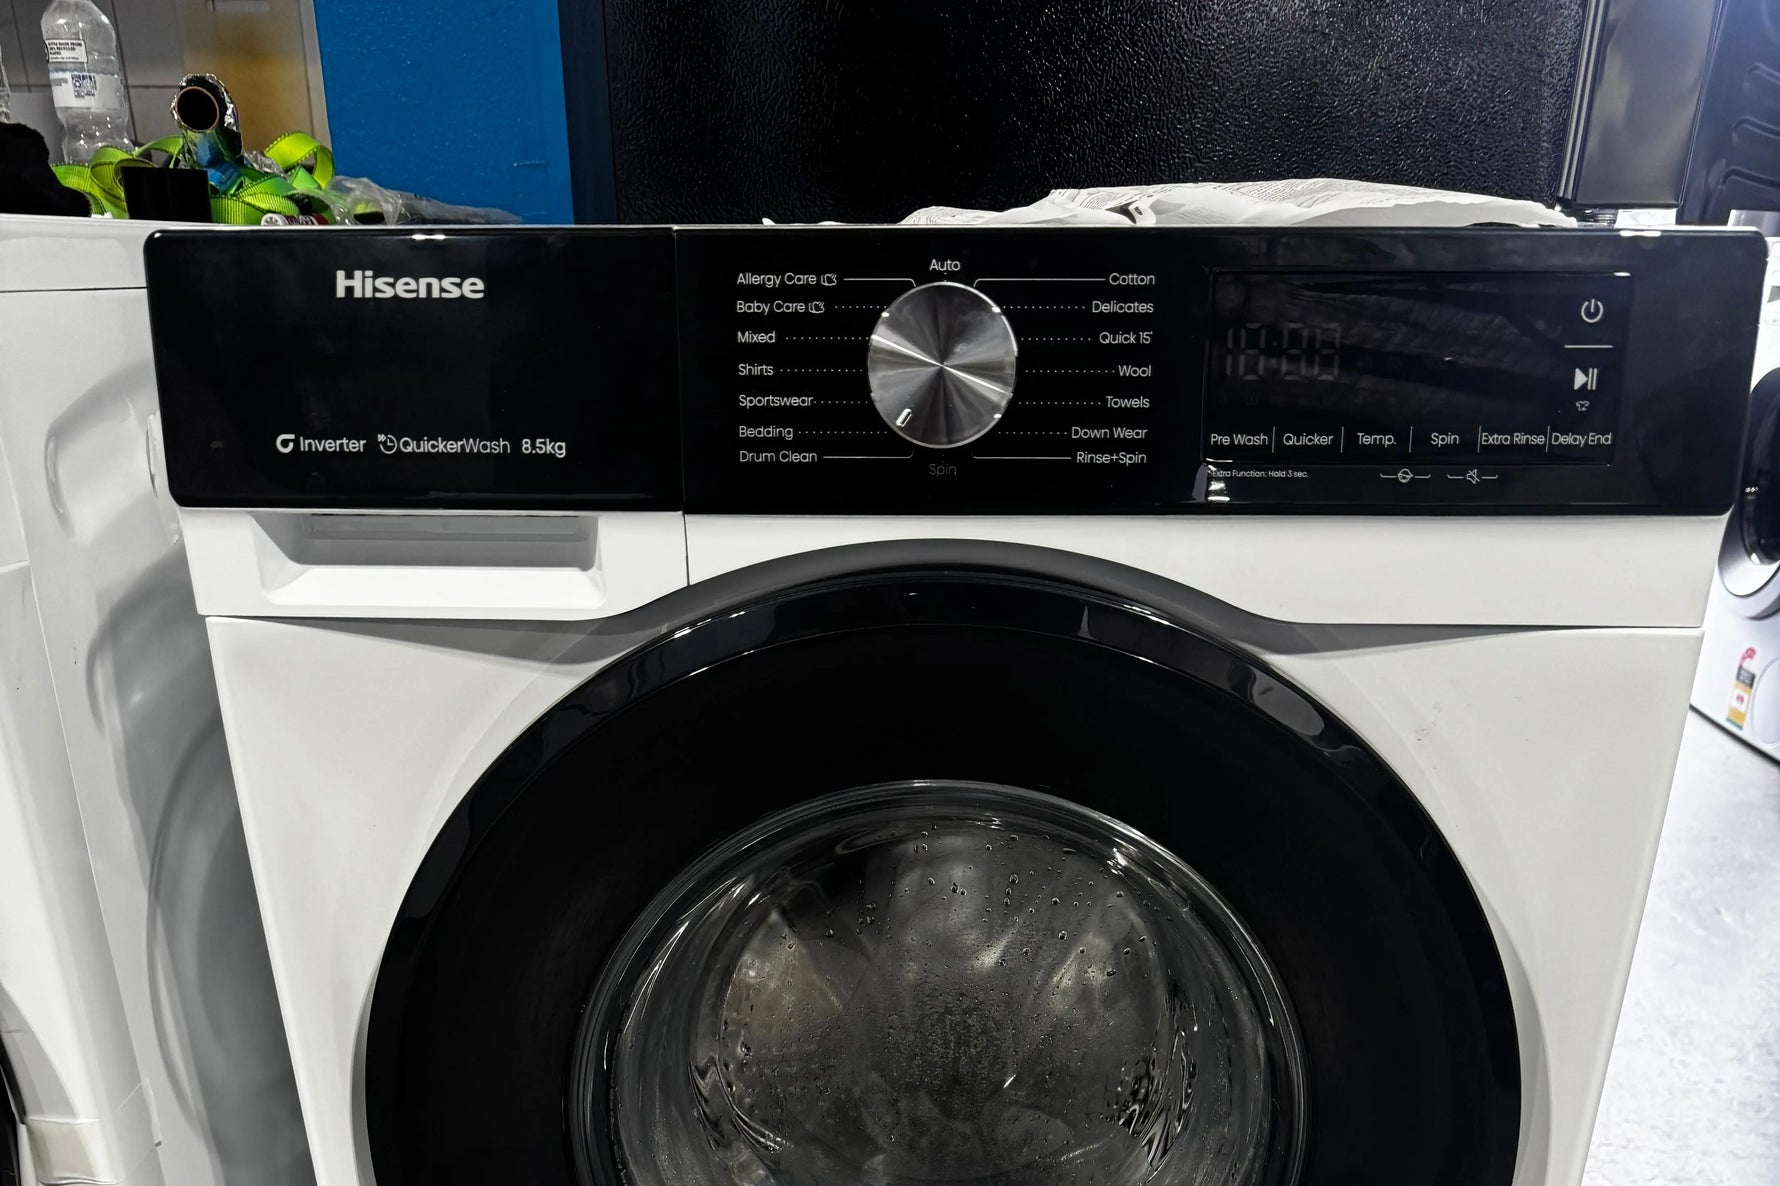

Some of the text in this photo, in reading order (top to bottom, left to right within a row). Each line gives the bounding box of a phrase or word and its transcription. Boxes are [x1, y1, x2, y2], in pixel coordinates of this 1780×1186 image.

[930, 258, 960, 271] Auto
[336, 270, 484, 298] Hisense
[736, 272, 816, 288] Allergy Care
[1109, 272, 1155, 286] Cotton
[736, 300, 806, 315] Baby Care
[1092, 300, 1154, 313] Delicates
[738, 331, 776, 342] Mixed
[1099, 332, 1136, 345] Quick
[738, 363, 774, 376] Shirts
[1118, 364, 1152, 376] Wool
[738, 394, 814, 409] Sportswear
[1106, 396, 1150, 408] Towels
[739, 425, 793, 440] Bedding
[1072, 426, 1148, 438] Down Wear
[1482, 432, 1546, 445] Extra Rinse
[300, 436, 366, 452] Inverter
[400, 437, 510, 454] QuickerWash
[1210, 434, 1268, 446] Pre Wash
[1282, 433, 1334, 446] Quicker
[1357, 432, 1396, 448] Temp.
[1430, 432, 1460, 447] Spin
[1552, 432, 1612, 447] Delay End
[521, 438, 566, 458] 8.5kg
[740, 450, 818, 462] Drum Clean
[1076, 452, 1146, 466] Rinse+Spin
[928, 464, 956, 477] Spin
